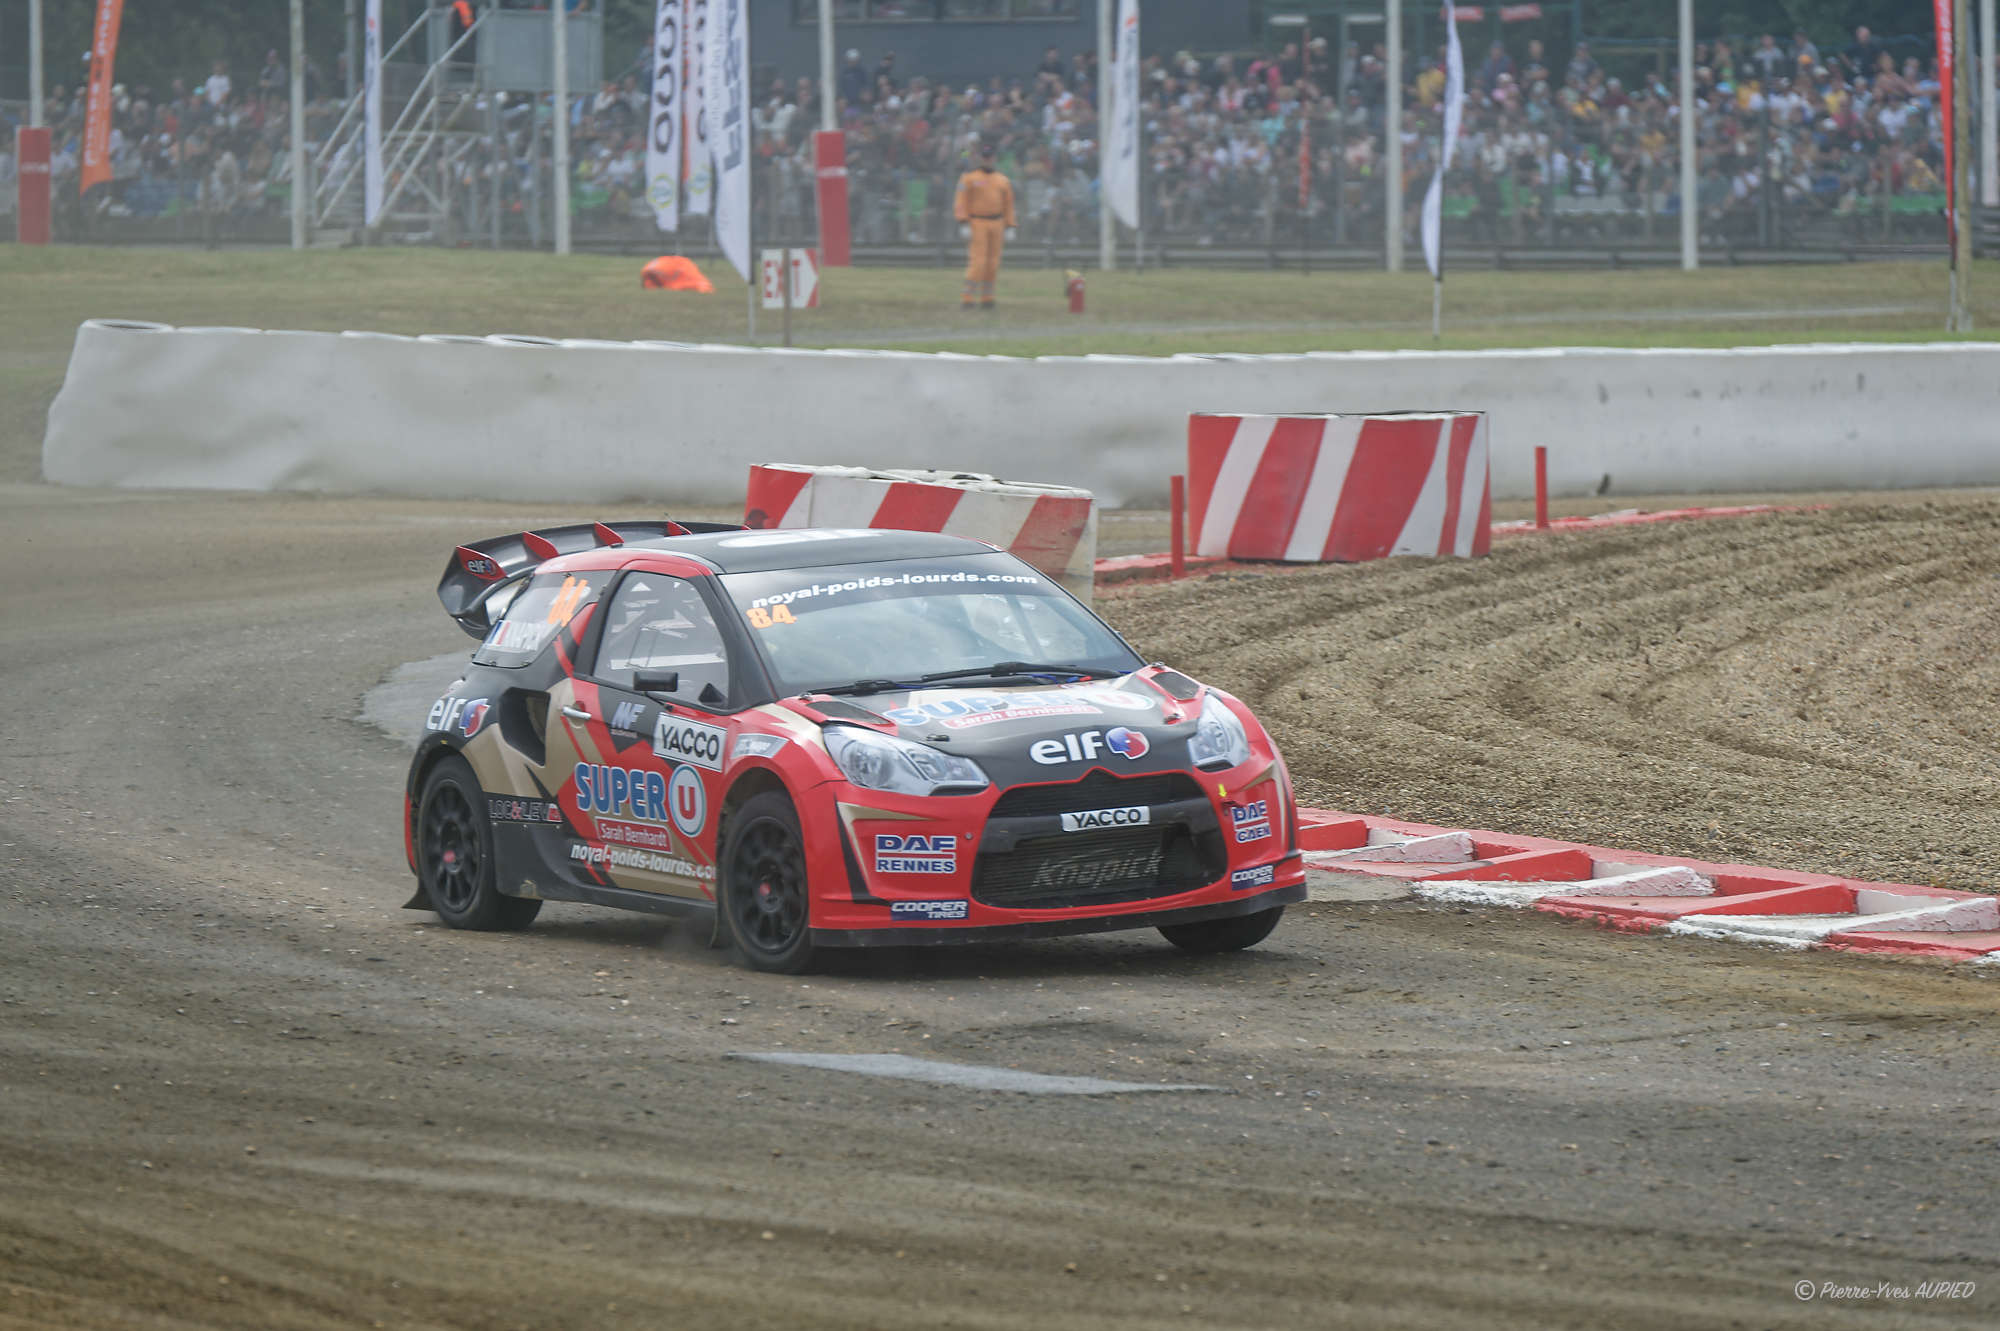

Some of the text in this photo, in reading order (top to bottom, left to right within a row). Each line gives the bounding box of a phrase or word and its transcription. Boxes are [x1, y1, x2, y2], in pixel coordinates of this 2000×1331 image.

[467, 560, 487, 574] elf
[752, 572, 1038, 609] noyal-poids-lourds.com
[746, 604, 797, 629] 84
[426, 697, 469, 731] elf
[953, 708, 1003, 726] Sarah
[661, 723, 720, 762] YACCO
[1030, 731, 1103, 765] elf
[575, 762, 668, 822] SUPER
[1072, 808, 1142, 829] YACCO
[1232, 801, 1267, 823] DAF
[600, 823, 668, 847] Sarah Bernhardt
[876, 835, 957, 851] DAF
[570, 844, 716, 880] noyal-poids-lourds.co
[877, 859, 957, 872] RENNES
[891, 902, 968, 912] COOPER
[928, 910, 966, 919] TIRES
